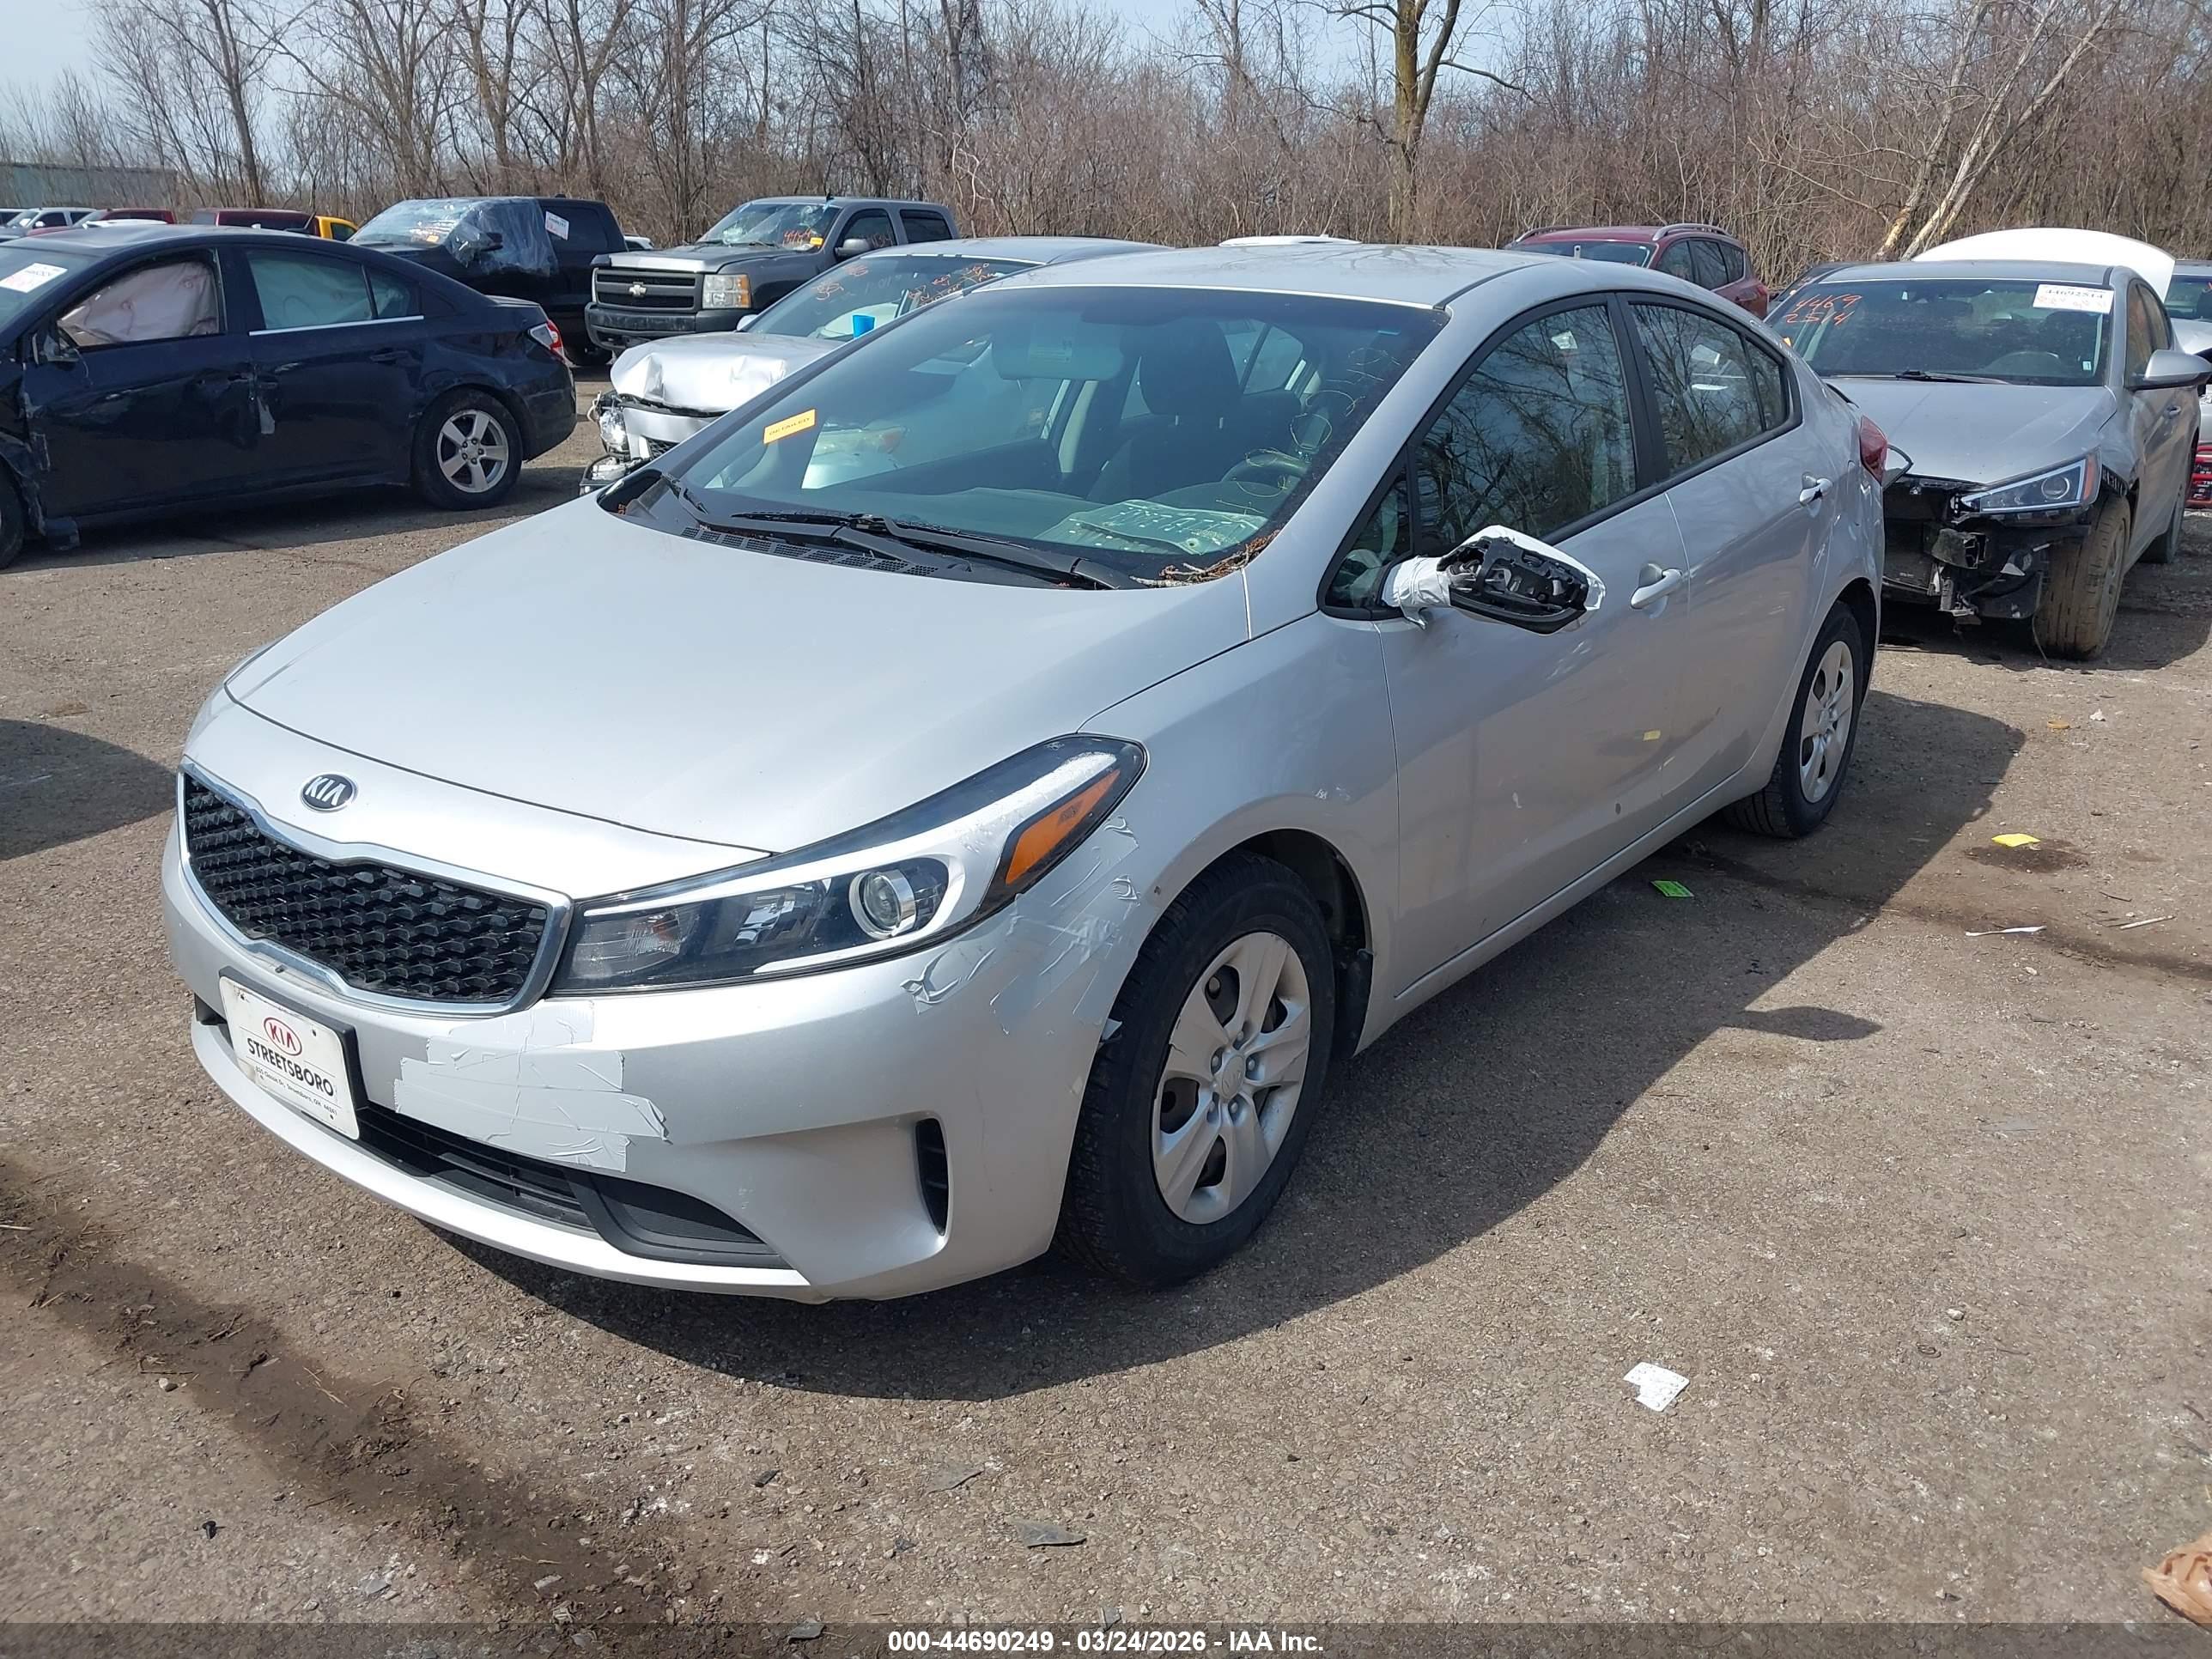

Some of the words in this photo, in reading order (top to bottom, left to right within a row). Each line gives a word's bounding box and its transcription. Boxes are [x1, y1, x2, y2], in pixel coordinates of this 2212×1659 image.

[1783, 310, 1856, 325] 2514
[1793, 294, 1863, 313] 4469
[305, 776, 346, 805] KIA
[269, 1022, 296, 1052] KIA
[247, 1037, 334, 1097] STREETSBORO
